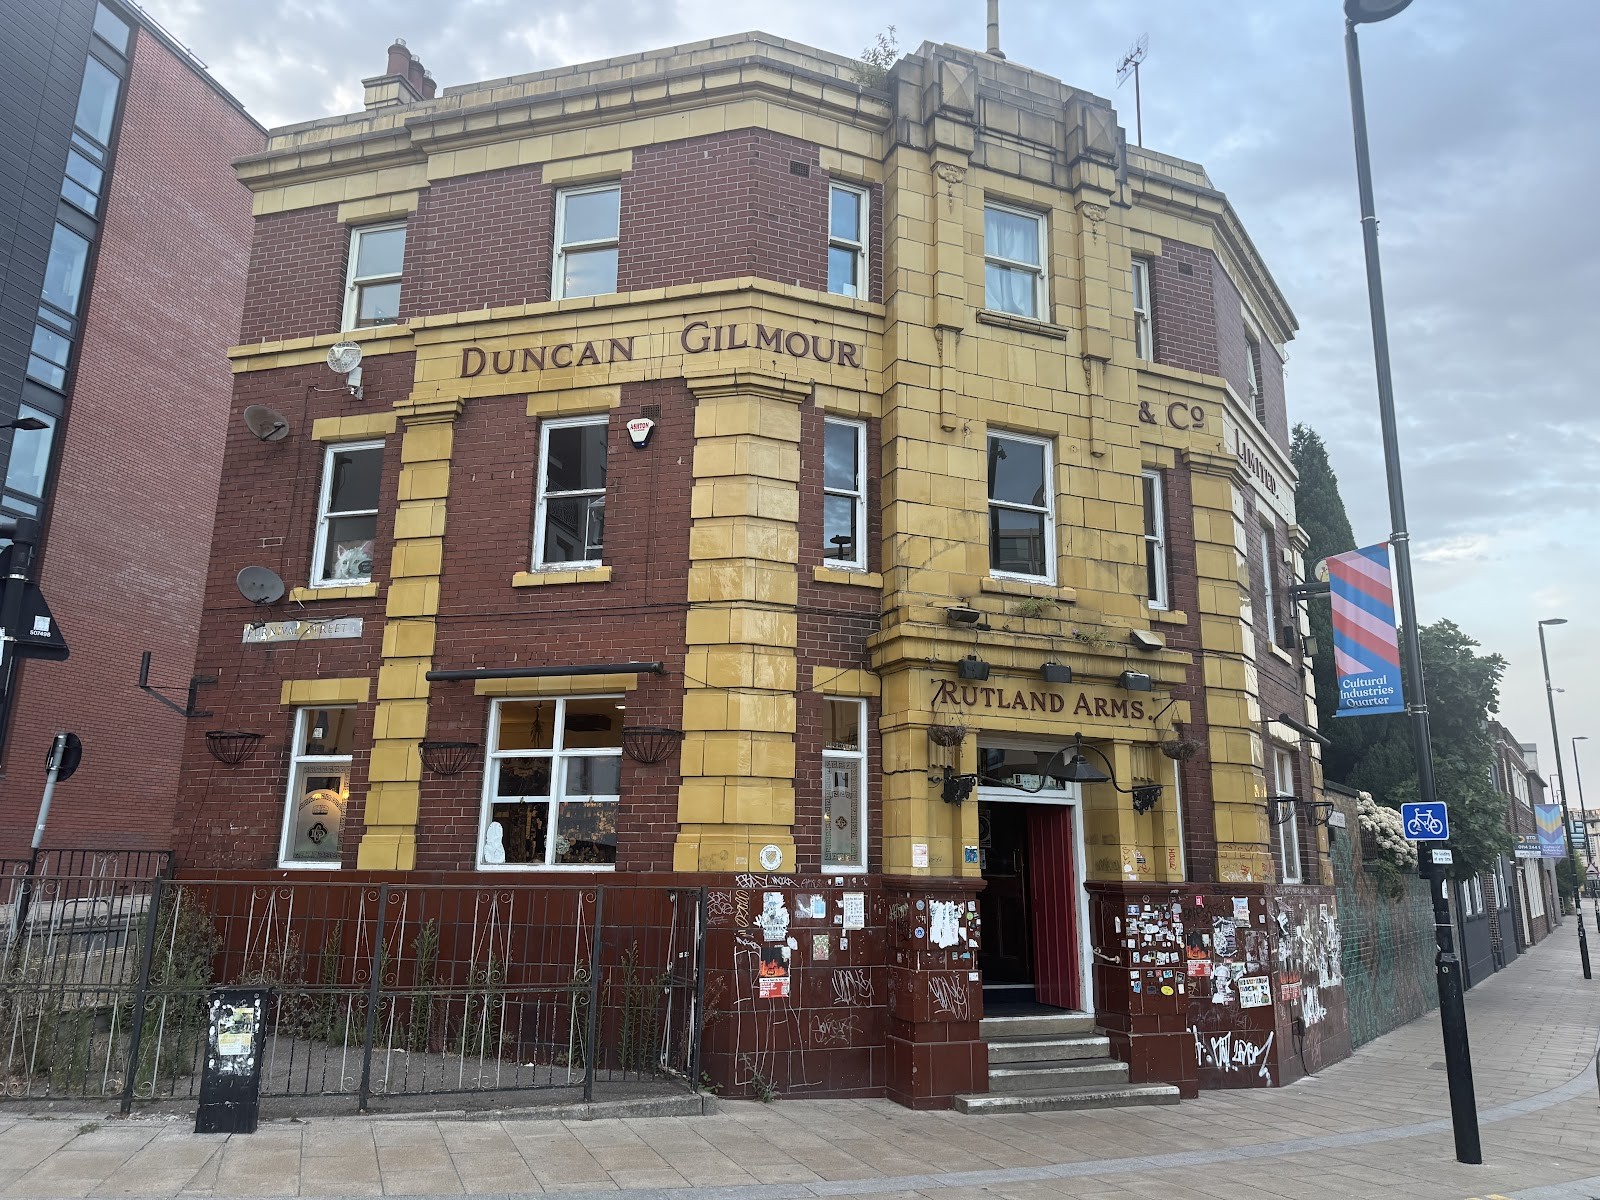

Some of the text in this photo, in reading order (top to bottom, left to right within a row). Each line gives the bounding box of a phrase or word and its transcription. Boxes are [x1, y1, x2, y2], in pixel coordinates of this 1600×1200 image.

[460, 336, 634, 378] DUNCAN
[681, 319, 861, 369] GILMOUR
[1138, 400, 1158, 425] &
[630, 422, 649, 430] ASHTON
[1342, 674, 1387, 689] Cultural
[940, 678, 1065, 713] RUTLAND
[1340, 685, 1394, 700] Industries
[1346, 697, 1389, 708] Quarter
